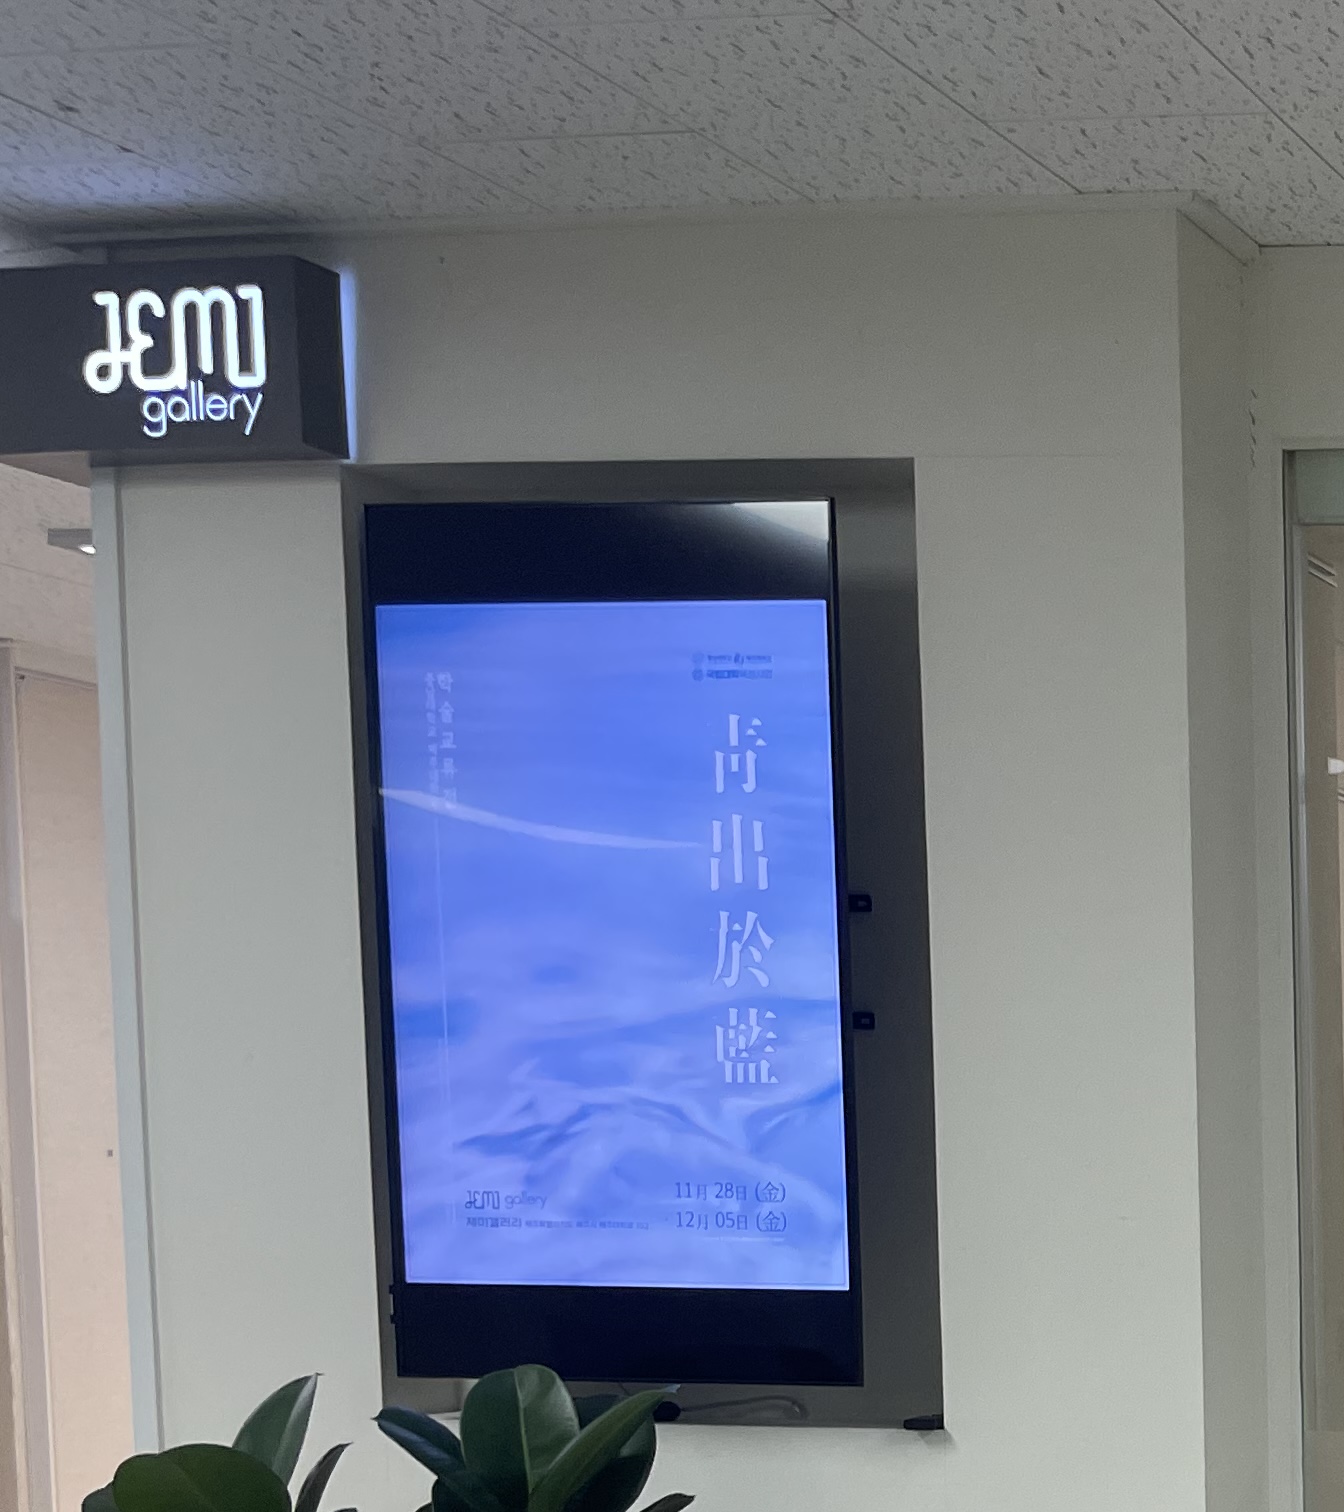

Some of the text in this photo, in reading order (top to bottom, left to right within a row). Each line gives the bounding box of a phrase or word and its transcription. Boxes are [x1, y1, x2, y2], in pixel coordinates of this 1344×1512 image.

[83, 283, 267, 394] JEMI
[142, 379, 264, 439] gallery
[504, 1191, 548, 1210] gallery
[675, 1181, 786, 1203] 11月 28日 (金)
[676, 1211, 787, 1232] 12月 05日 (金)
